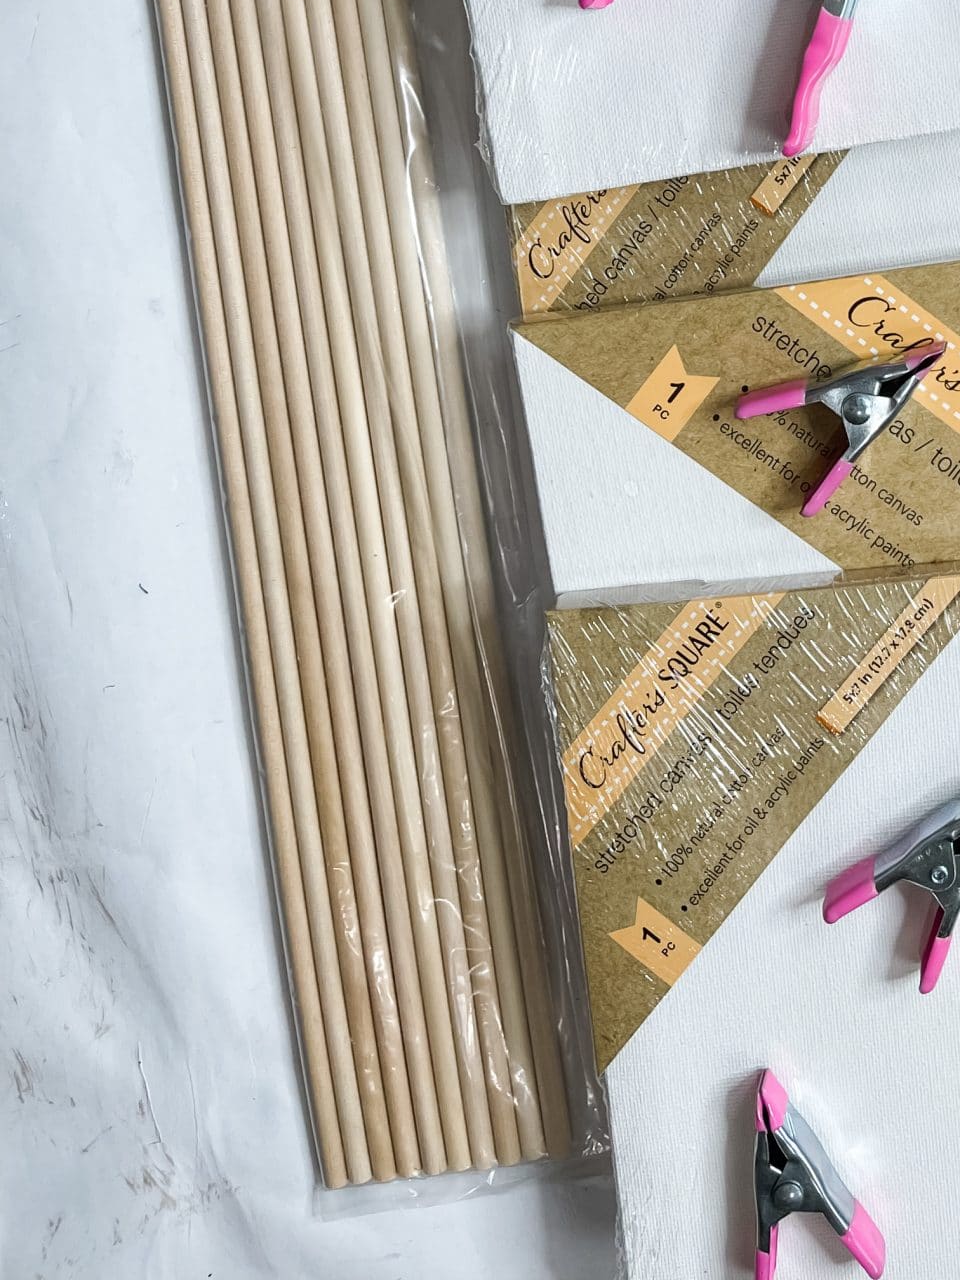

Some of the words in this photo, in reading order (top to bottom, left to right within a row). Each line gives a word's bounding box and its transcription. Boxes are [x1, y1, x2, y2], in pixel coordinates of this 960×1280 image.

[775, 165, 792, 185] 5x7
[605, 220, 653, 280] canvas
[664, 251, 693, 289] cotton
[691, 212, 721, 252] canvas
[731, 219, 758, 257] paints
[652, 404, 670, 420] PC
[667, 382, 685, 403] 1
[719, 422, 780, 471] excellent
[780, 461, 801, 484] for
[878, 487, 923, 526] canvas
[830, 502, 877, 540] acrylic
[870, 535, 915, 569] paints
[754, 606, 816, 675] tendues
[868, 647, 891, 674] (12.7
[914, 598, 934, 621] cm)
[579, 688, 666, 789] Crafter's
[658, 609, 730, 690] SQUARE
[689, 850, 734, 907] excellent
[728, 833, 748, 856] for
[744, 817, 761, 835] oil
[765, 770, 797, 809] acrylic
[796, 737, 825, 775] paints
[661, 845, 693, 879] 100%
[642, 926, 662, 944] 1
[661, 941, 676, 957] PC
